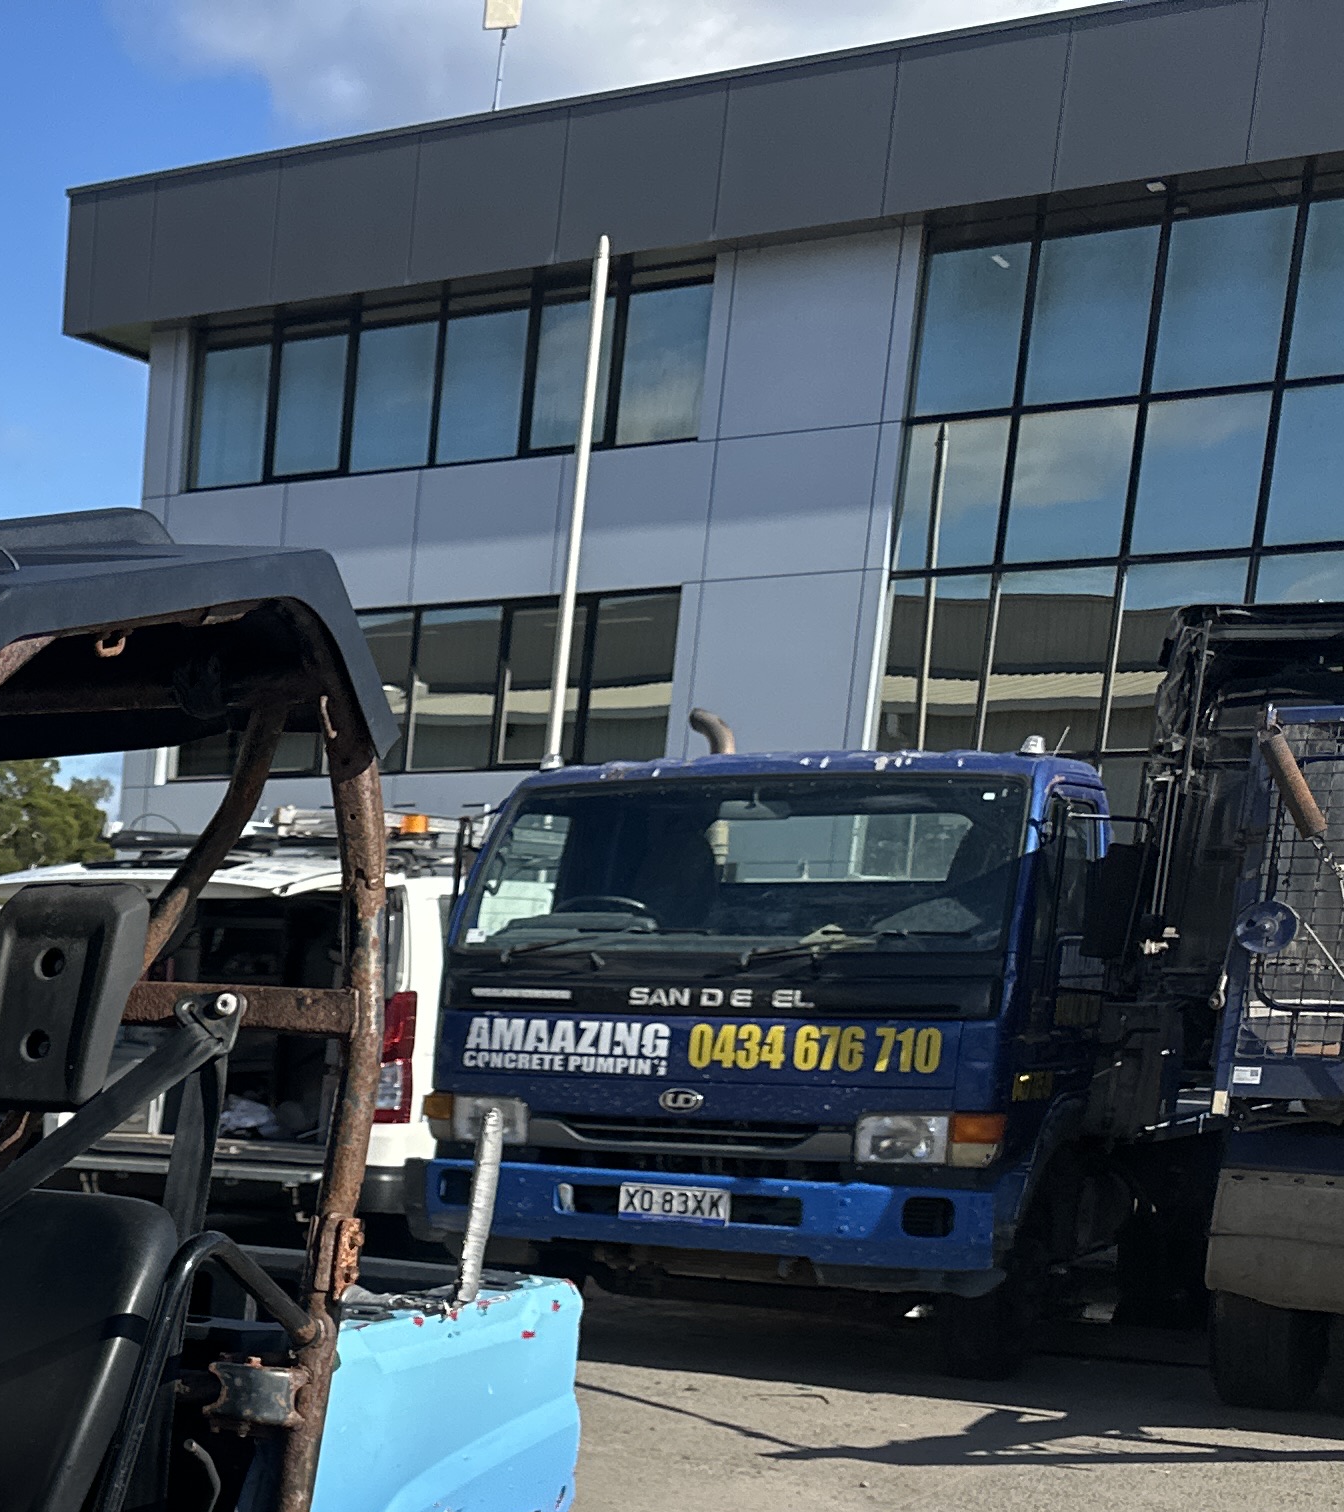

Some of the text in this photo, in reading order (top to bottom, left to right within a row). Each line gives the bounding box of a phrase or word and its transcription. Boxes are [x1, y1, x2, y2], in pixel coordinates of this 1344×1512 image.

[465, 1016, 672, 1058] AMAAZING
[688, 1023, 943, 1074] 0434 676 710
[463, 1050, 568, 1071] CONCRETE
